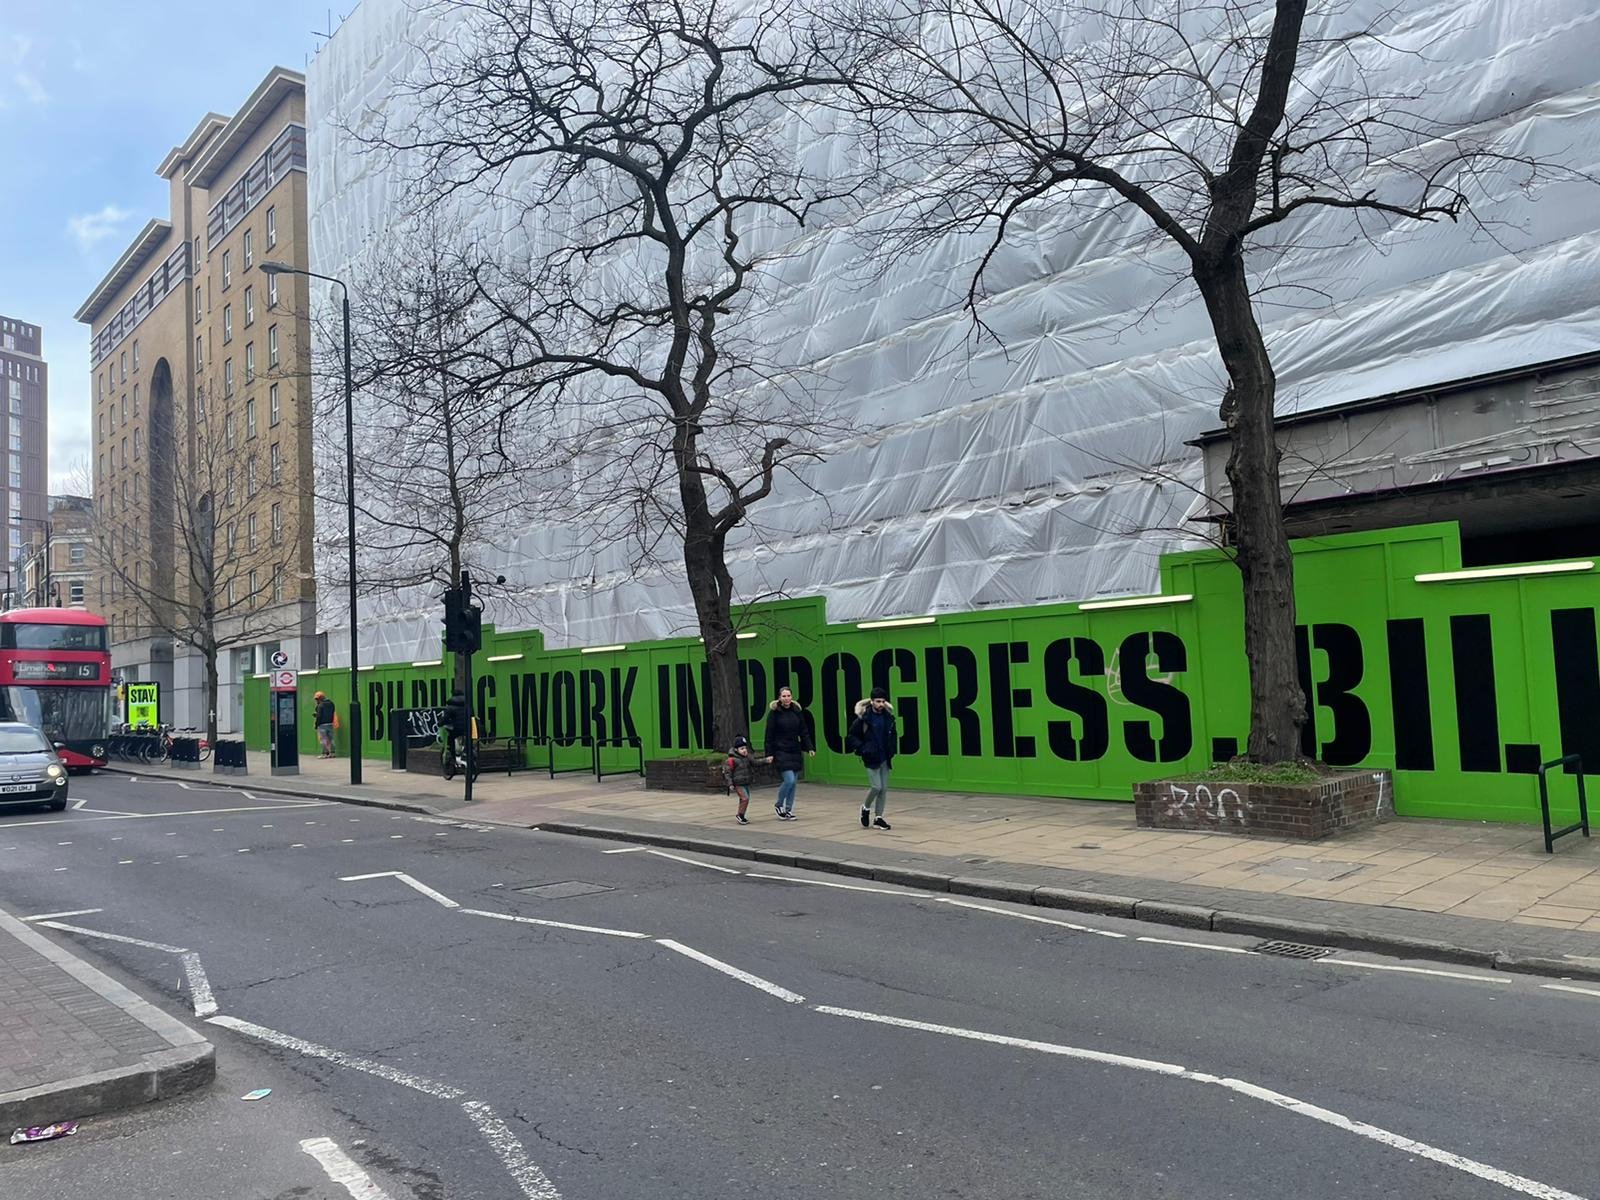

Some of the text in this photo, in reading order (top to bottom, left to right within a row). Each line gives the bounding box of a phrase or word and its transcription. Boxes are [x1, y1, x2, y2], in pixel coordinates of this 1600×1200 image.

[19, 664, 67, 672] Limehse
[79, 665, 90, 676] 15
[131, 689, 156, 703] STAY.
[510, 666, 639, 748] WORK
[657, 662, 714, 749] IN
